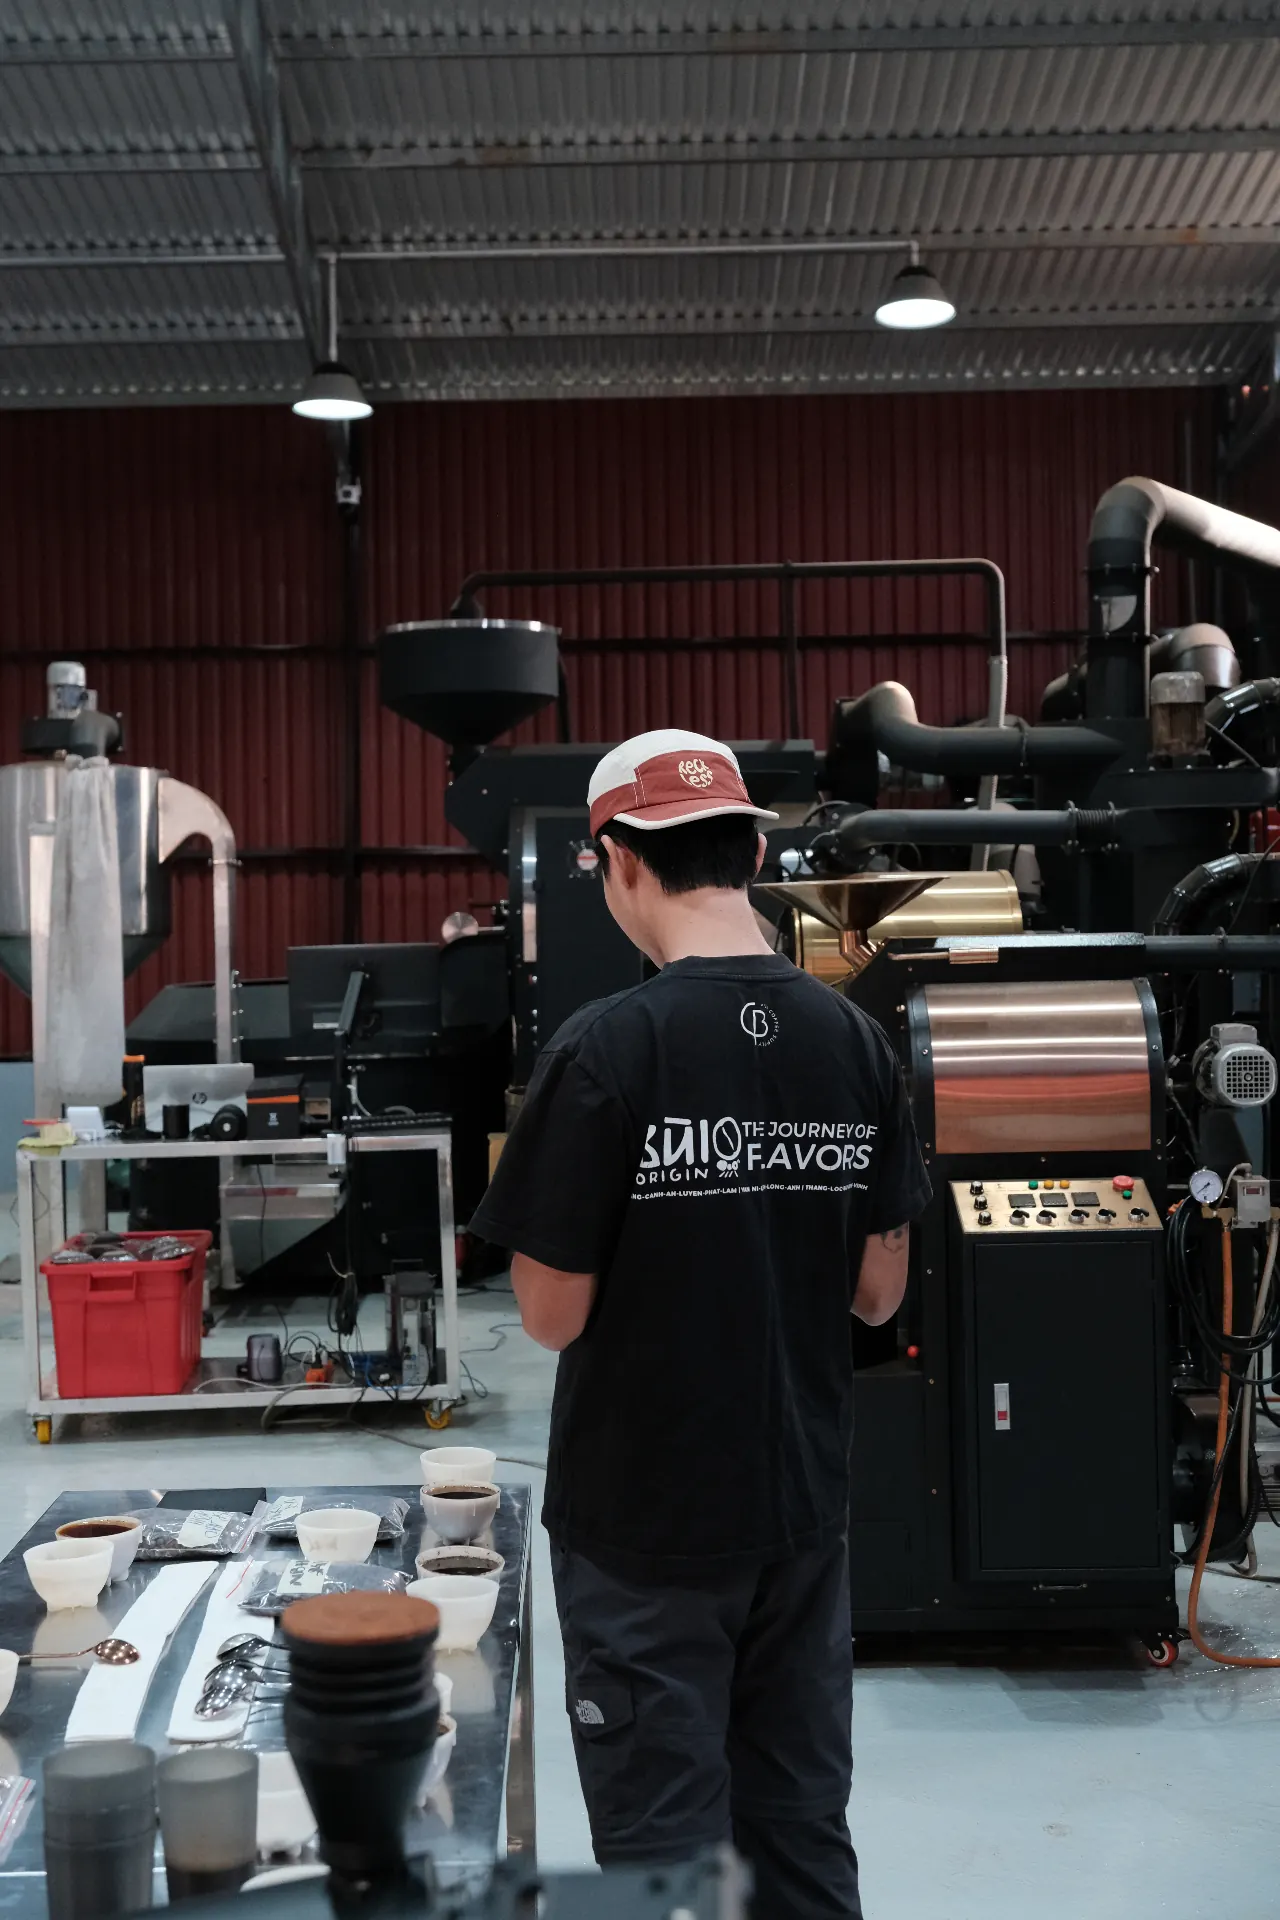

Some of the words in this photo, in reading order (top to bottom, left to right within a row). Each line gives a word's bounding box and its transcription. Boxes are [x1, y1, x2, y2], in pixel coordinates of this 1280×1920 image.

[742, 1121, 765, 1138] THE
[768, 1121, 855, 1139] JOURNEY
[855, 1123, 878, 1139] OF
[747, 1142, 873, 1171] FAVORS
[636, 1168, 709, 1185] ORIGIN
